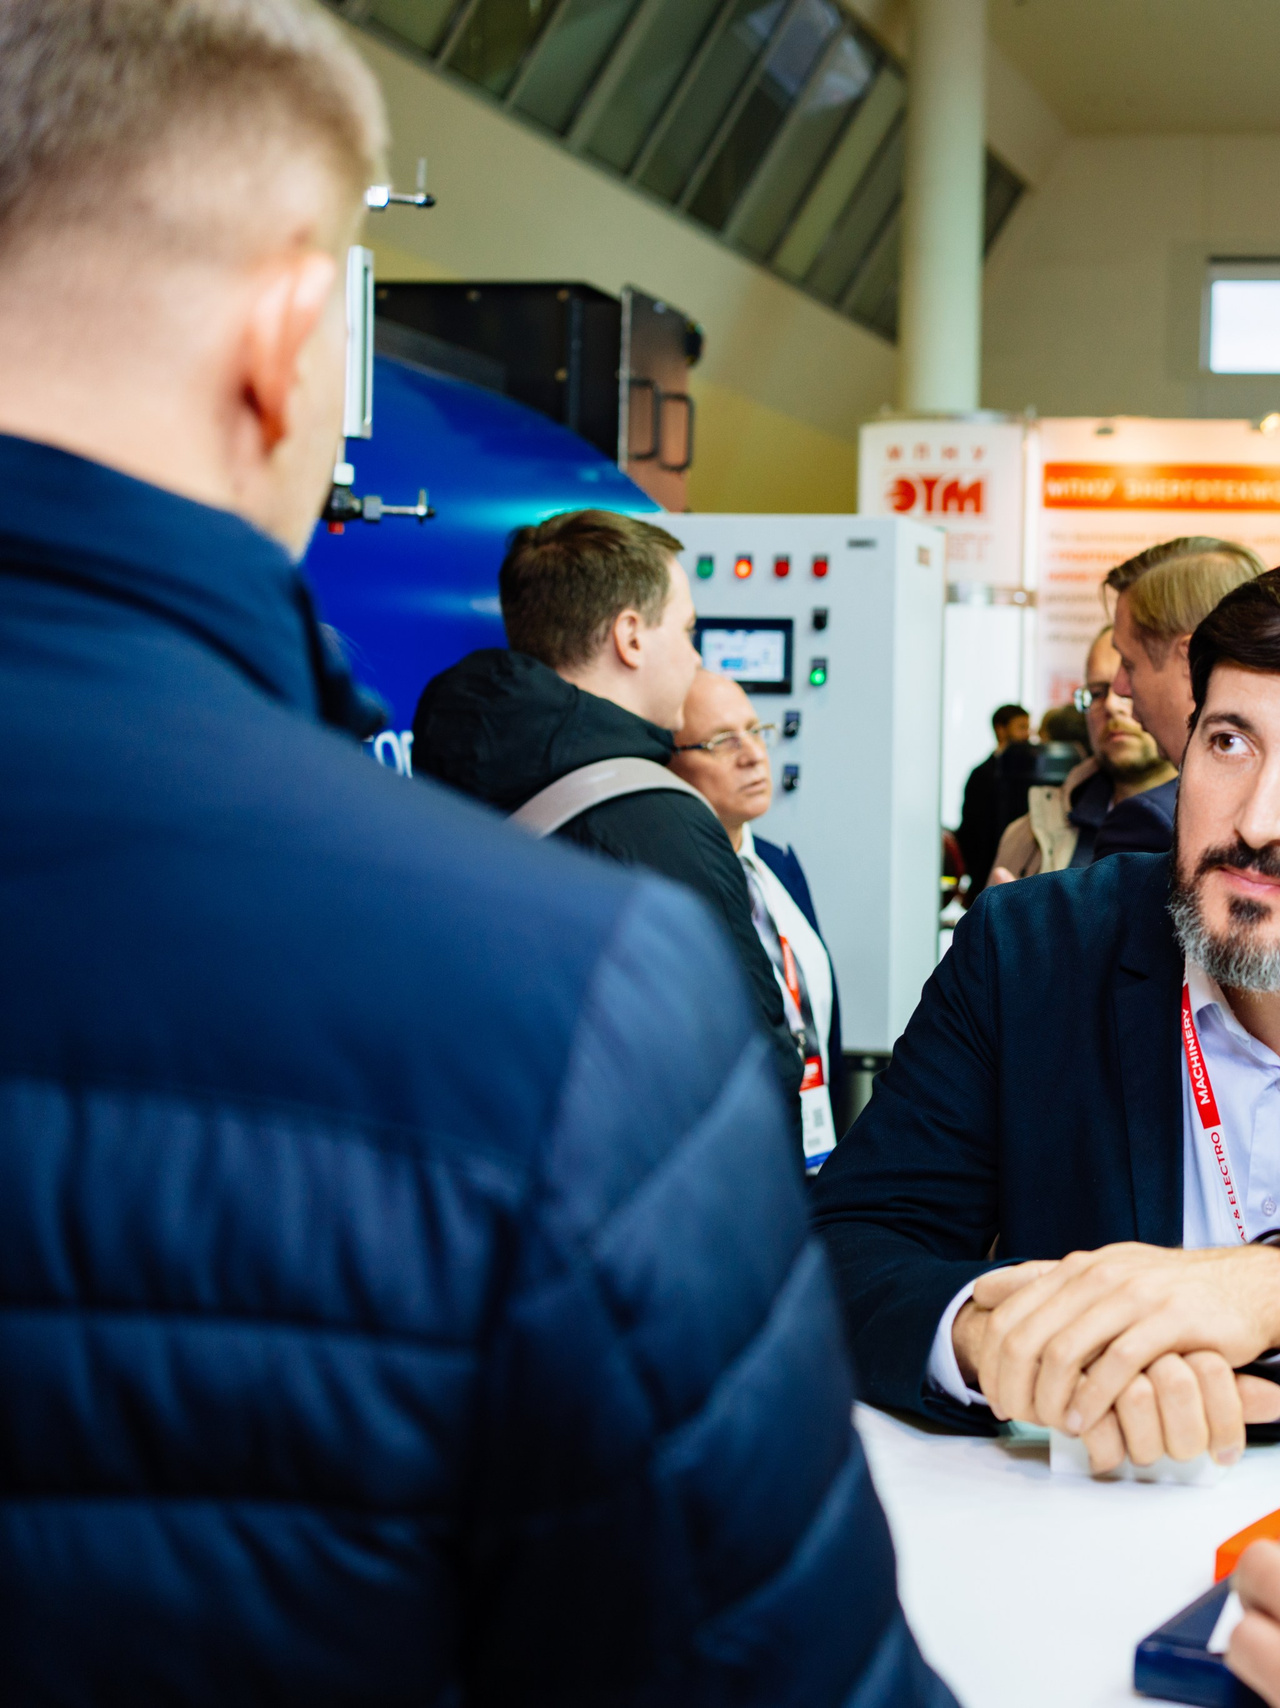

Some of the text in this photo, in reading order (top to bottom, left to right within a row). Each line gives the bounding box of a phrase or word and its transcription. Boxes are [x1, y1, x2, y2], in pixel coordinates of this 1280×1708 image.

[886, 475, 984, 515] ЭТМ
[1182, 1008, 1211, 1105] MACHINERY
[1210, 1131, 1237, 1205] ELECTRO
